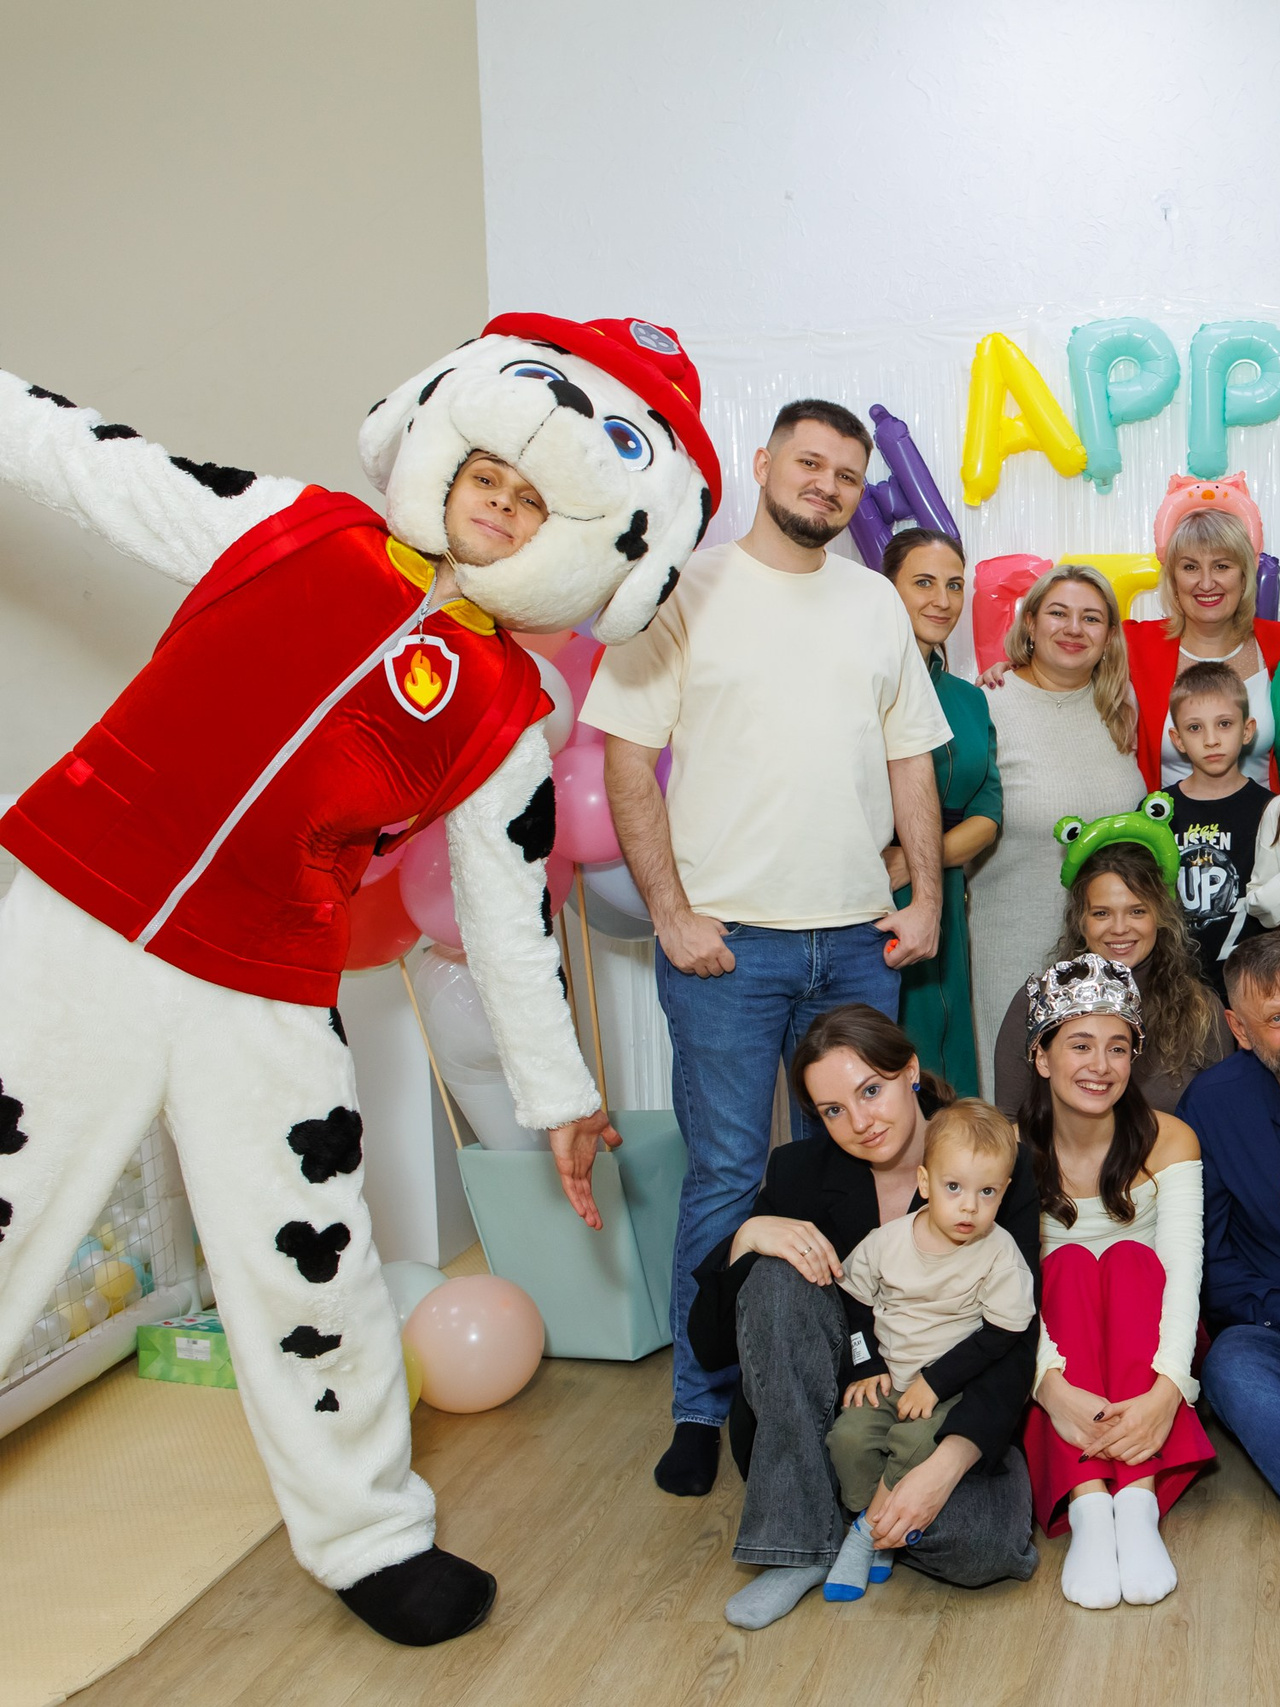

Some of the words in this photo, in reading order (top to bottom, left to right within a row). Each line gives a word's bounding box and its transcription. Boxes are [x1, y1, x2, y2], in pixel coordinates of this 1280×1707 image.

[1175, 831, 1232, 851] LISTEN
[1186, 823, 1219, 841] Hey
[1178, 866, 1228, 912] UP
